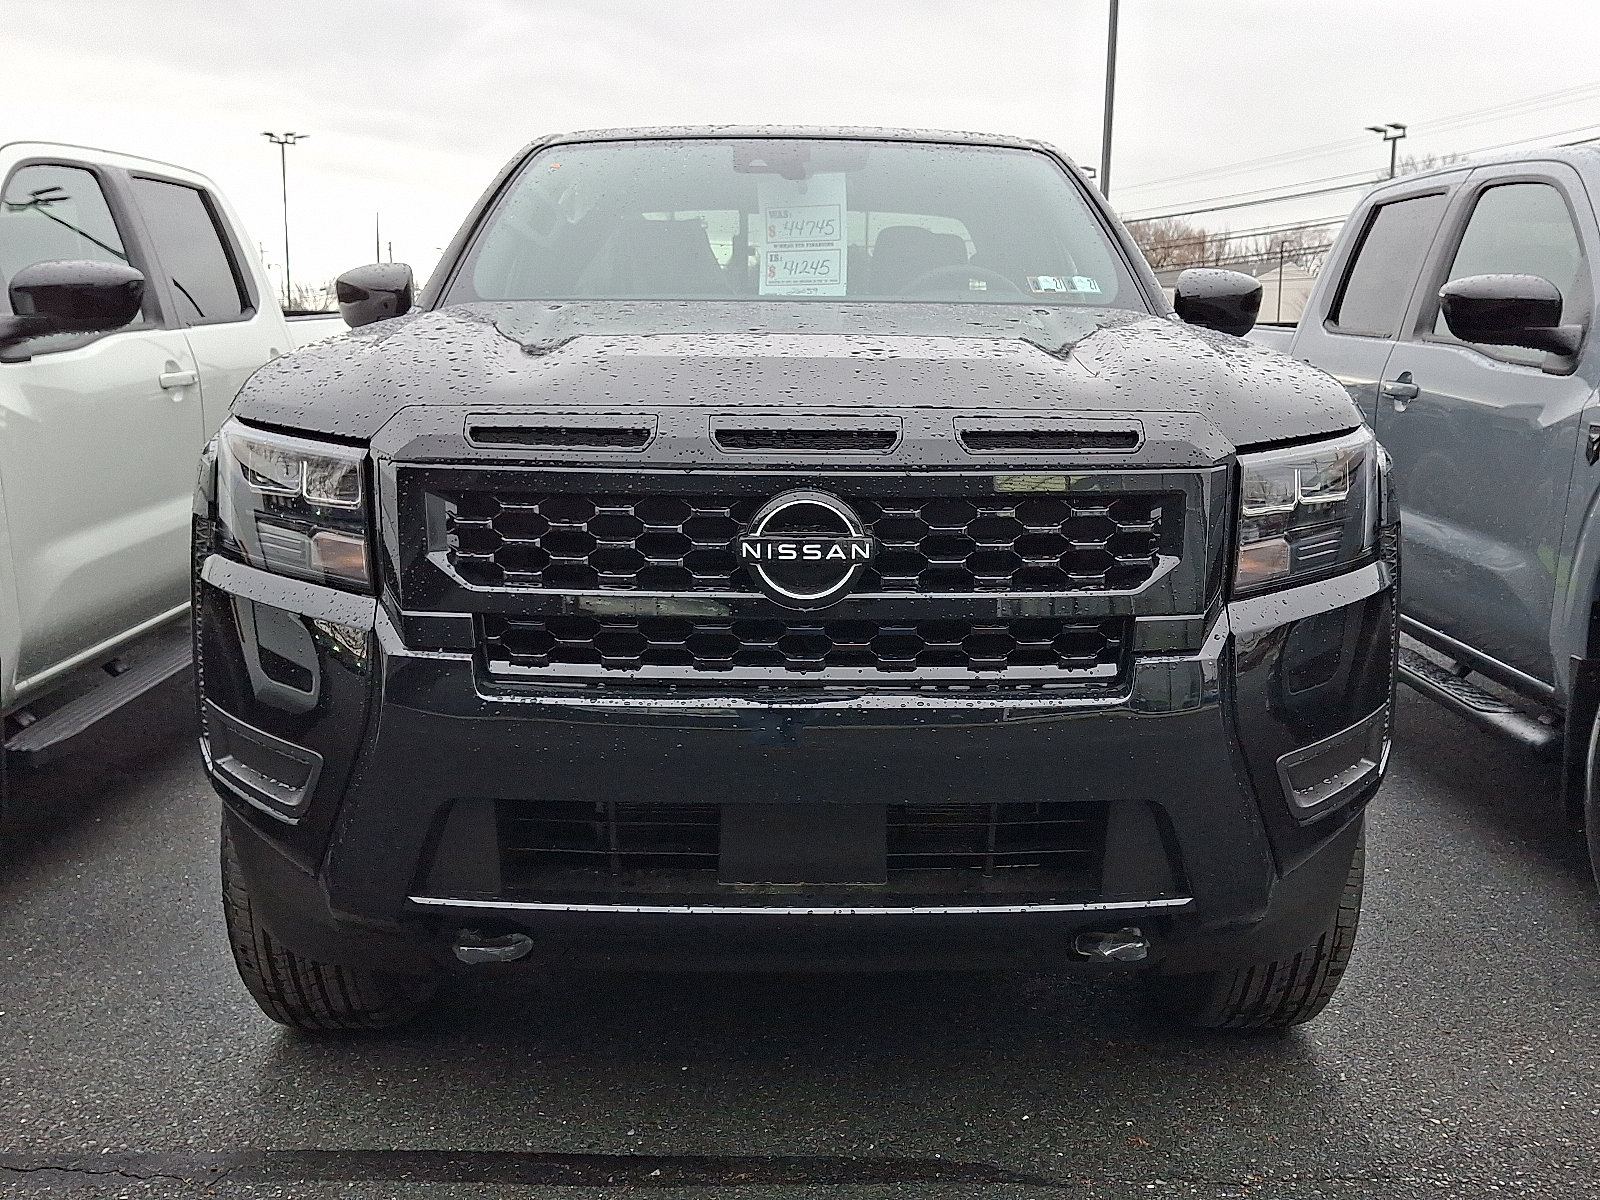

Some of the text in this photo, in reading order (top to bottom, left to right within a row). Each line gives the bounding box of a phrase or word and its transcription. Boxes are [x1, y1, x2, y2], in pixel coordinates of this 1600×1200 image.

[782, 219, 835, 237] 44745
[769, 254, 783, 262] IS:
[783, 259, 831, 276] 41245
[741, 542, 870, 560] NISSAN
